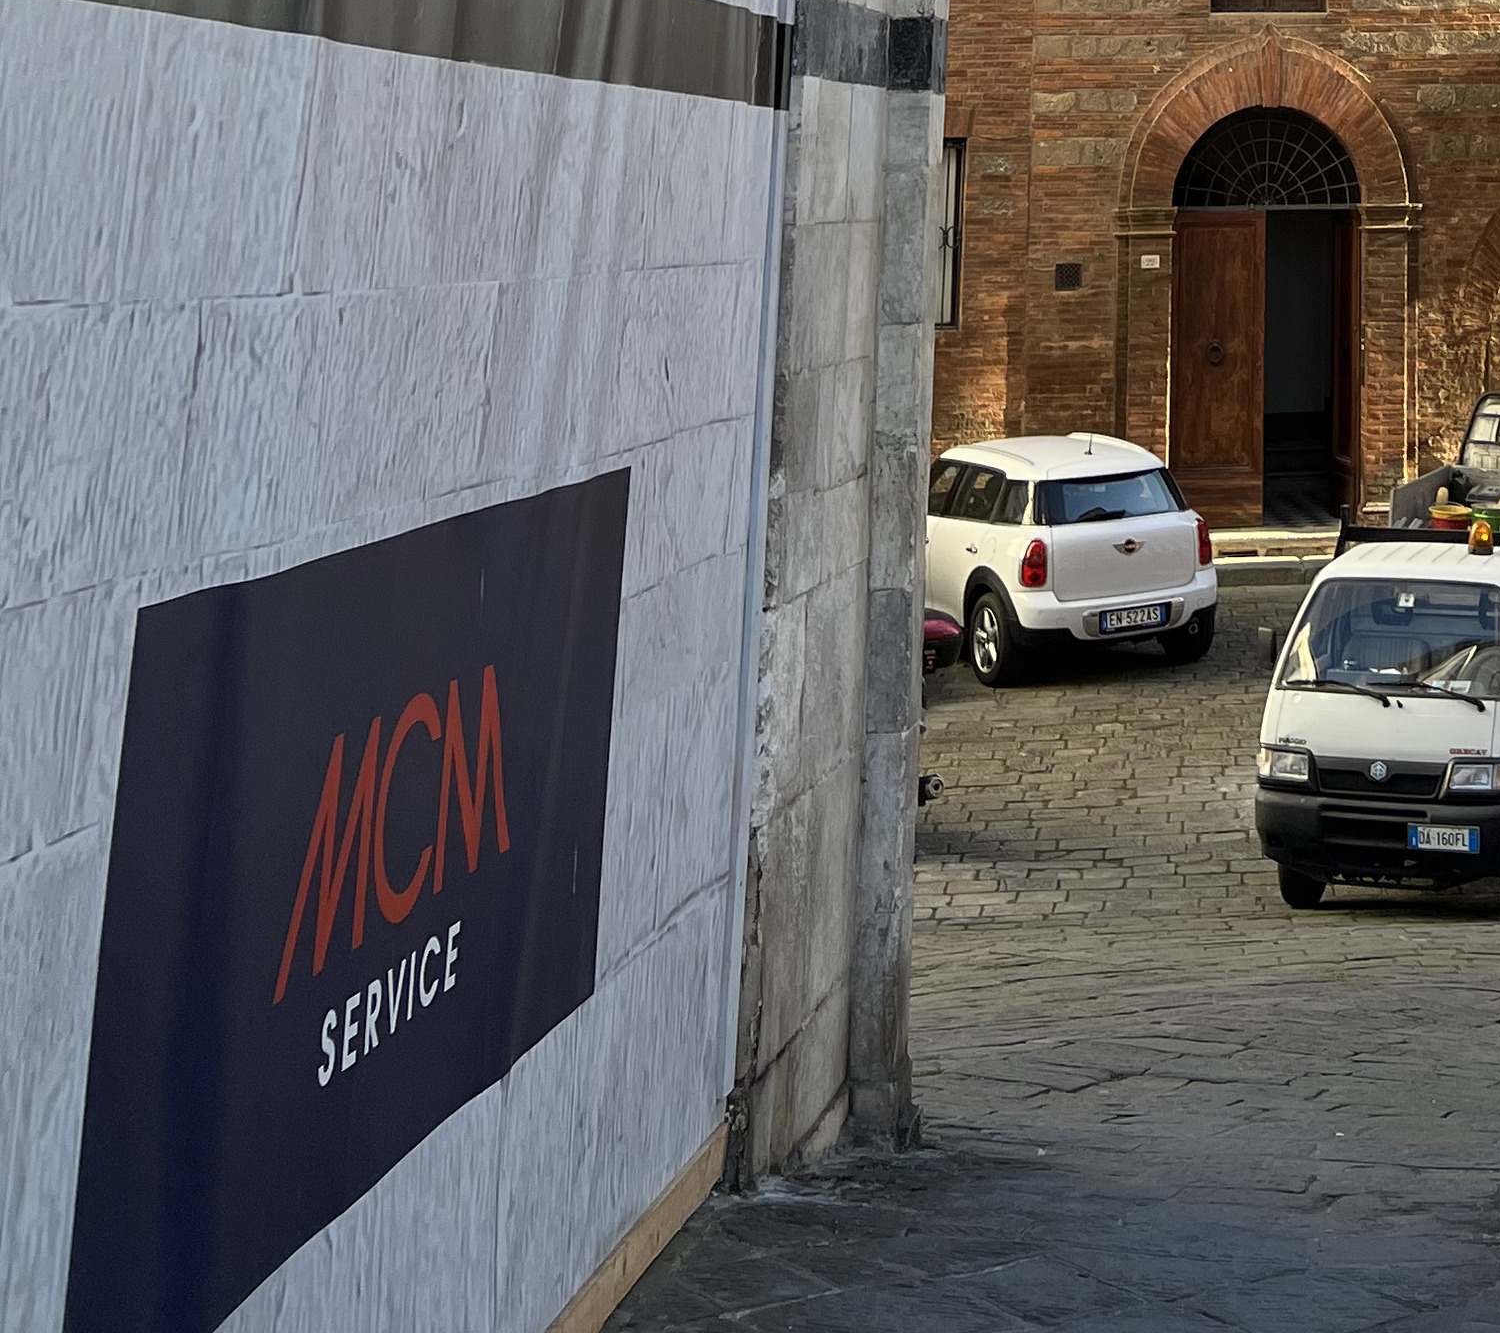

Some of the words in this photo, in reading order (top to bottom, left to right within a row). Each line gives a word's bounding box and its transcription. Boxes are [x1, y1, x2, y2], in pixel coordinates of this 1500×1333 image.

[1108, 612, 1123, 627] EN
[1126, 607, 1159, 624] 522AS
[272, 664, 511, 1006] MCM
[1418, 831, 1432, 846] DA
[1436, 832, 1469, 847] 160FL
[317, 920, 462, 1087] SERVICE
